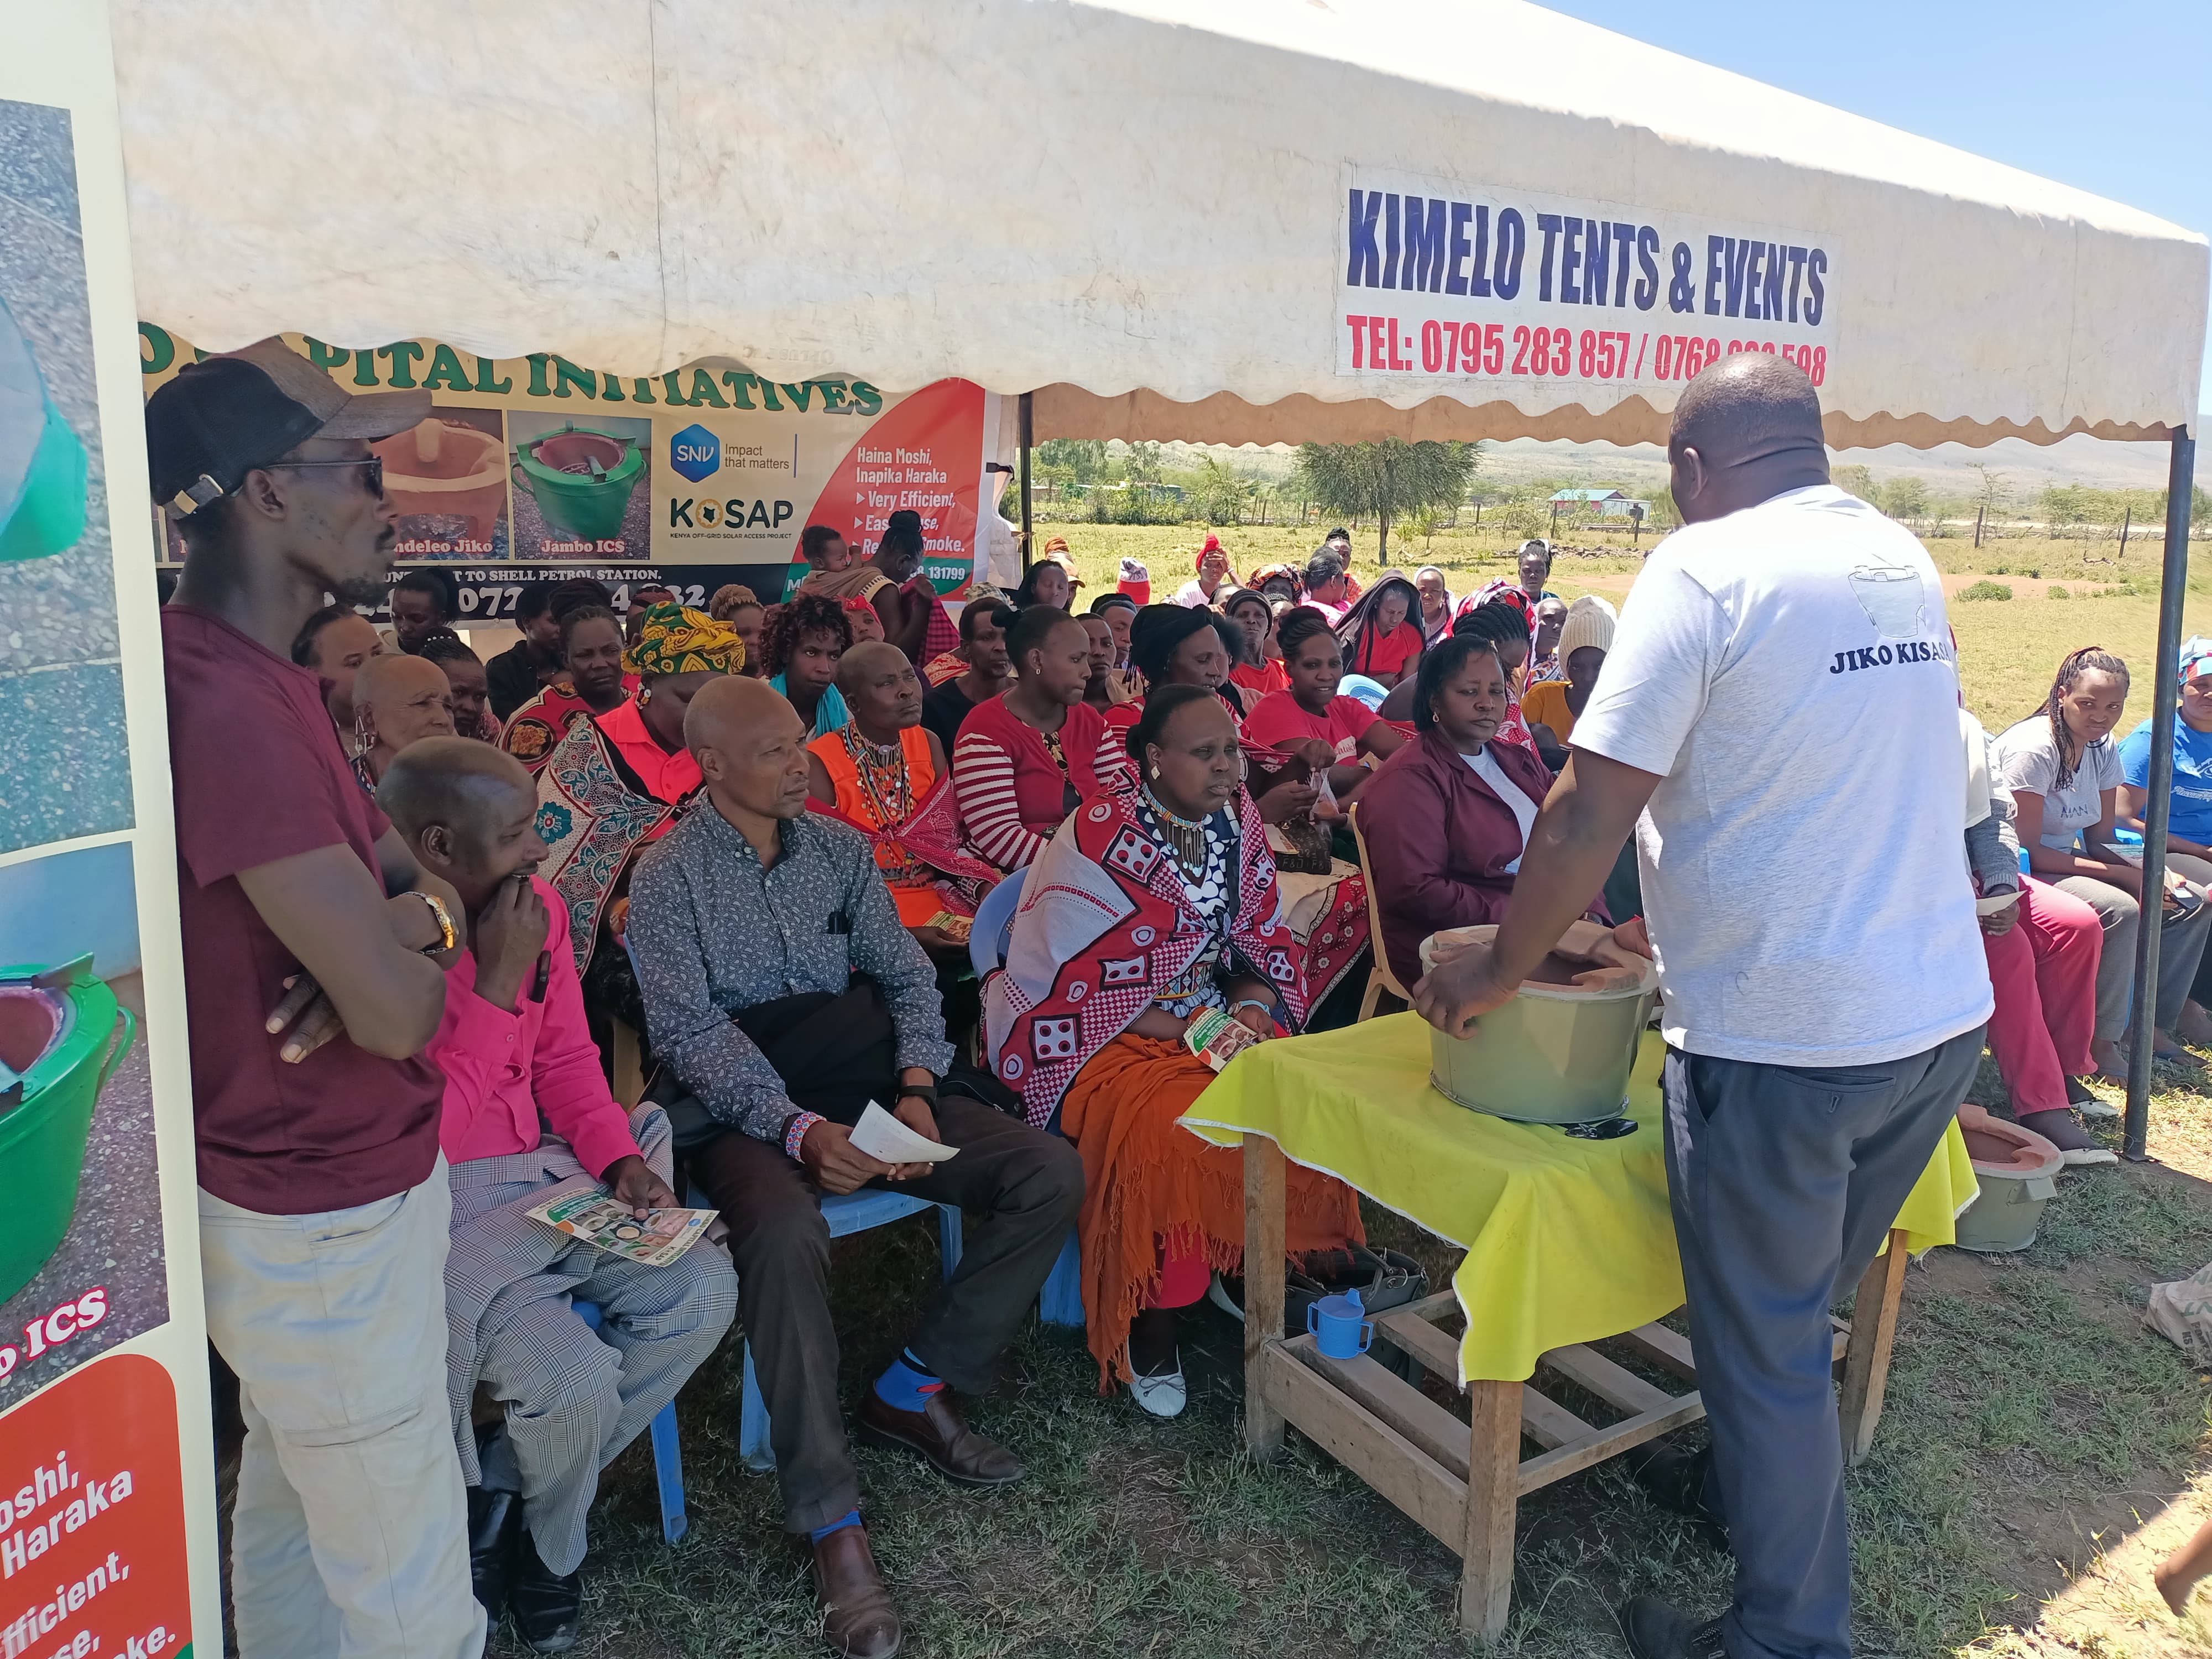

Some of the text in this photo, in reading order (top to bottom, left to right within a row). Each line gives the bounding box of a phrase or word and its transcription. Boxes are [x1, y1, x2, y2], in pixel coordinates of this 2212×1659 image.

[1347, 188, 1828, 326] KIMELO TENTS & EVENTS
[1347, 315, 1412, 371] TEL:
[1422, 320, 1504, 375] 0795
[1512, 325, 1571, 377] 283
[1579, 330, 1631, 379] 857
[1655, 335, 1720, 381] 0768
[526, 352, 883, 416] INITIATIVES
[676, 444, 763, 462] SNV Impact
[724, 457, 790, 469] that matters
[857, 447, 932, 466] Haina Moshi,
[857, 467, 947, 487] Inapika Haraka
[868, 490, 956, 511] Very Efficient,
[670, 498, 794, 529] KOSAP
[865, 514, 890, 531] Eas
[454, 539, 493, 553] Jiko
[541, 540, 625, 553] Jambo ICS
[465, 570, 487, 582] TO
[489, 570, 536, 582] SHELL
[539, 570, 596, 582] PETROL
[597, 569, 662, 581] STATION.
[928, 566, 966, 581] 131799
[1830, 645, 1893, 674] JIKO
[25, 1289, 106, 1358] ICS
[1, 1470, 133, 1580] Haraka
[0, 1552, 129, 1659] fficient,
